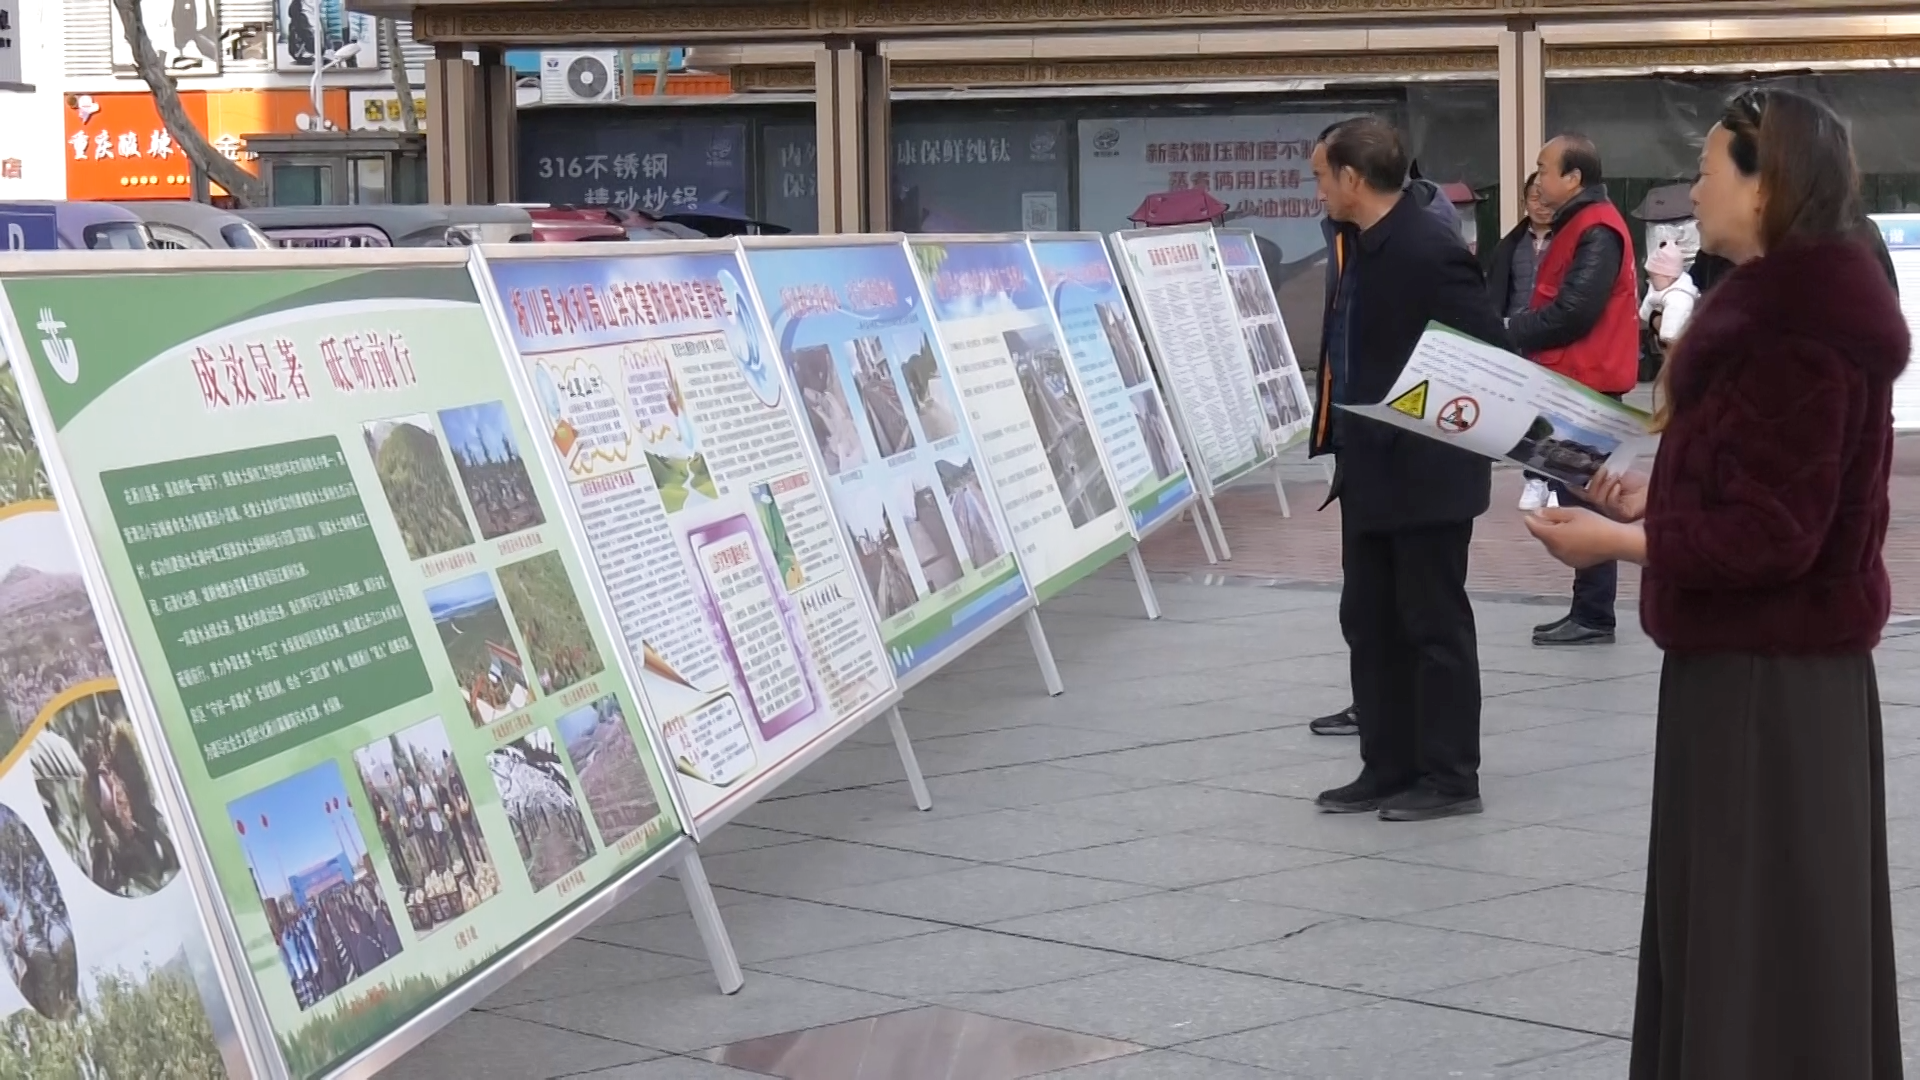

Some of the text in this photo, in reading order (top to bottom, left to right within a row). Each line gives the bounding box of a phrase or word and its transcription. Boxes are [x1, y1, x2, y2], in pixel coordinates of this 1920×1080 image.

[68, 128, 188, 161] 重庆酸辣
[538, 152, 669, 180] 316不锈钢
[190, 331, 417, 409] 成效显著 砥砺前行
